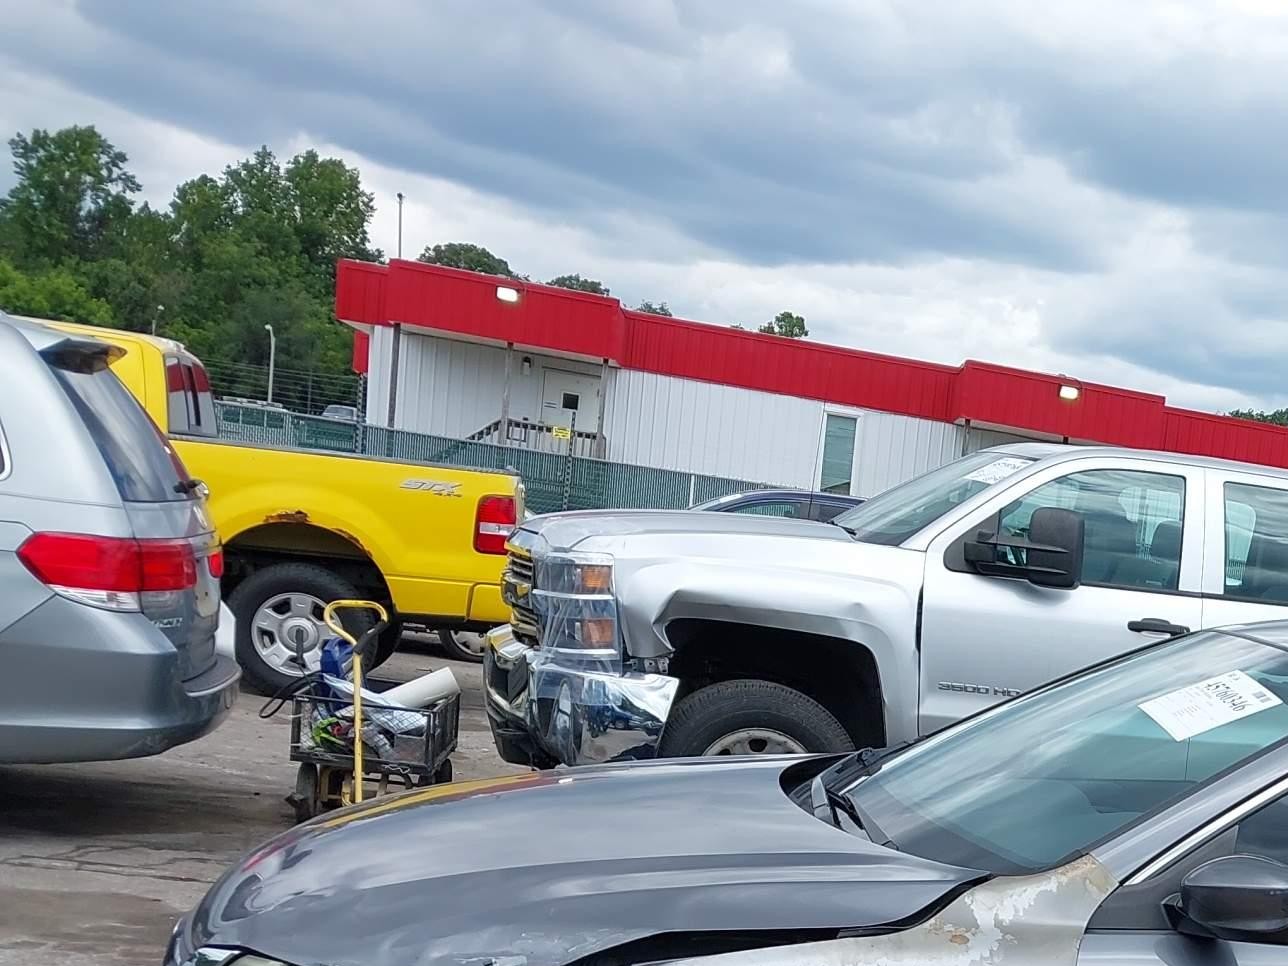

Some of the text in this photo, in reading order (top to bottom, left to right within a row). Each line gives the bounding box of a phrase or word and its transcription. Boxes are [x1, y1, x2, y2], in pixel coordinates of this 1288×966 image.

[938, 681, 1021, 697] 3500 HD
[1205, 681, 1252, 712] 45760346
